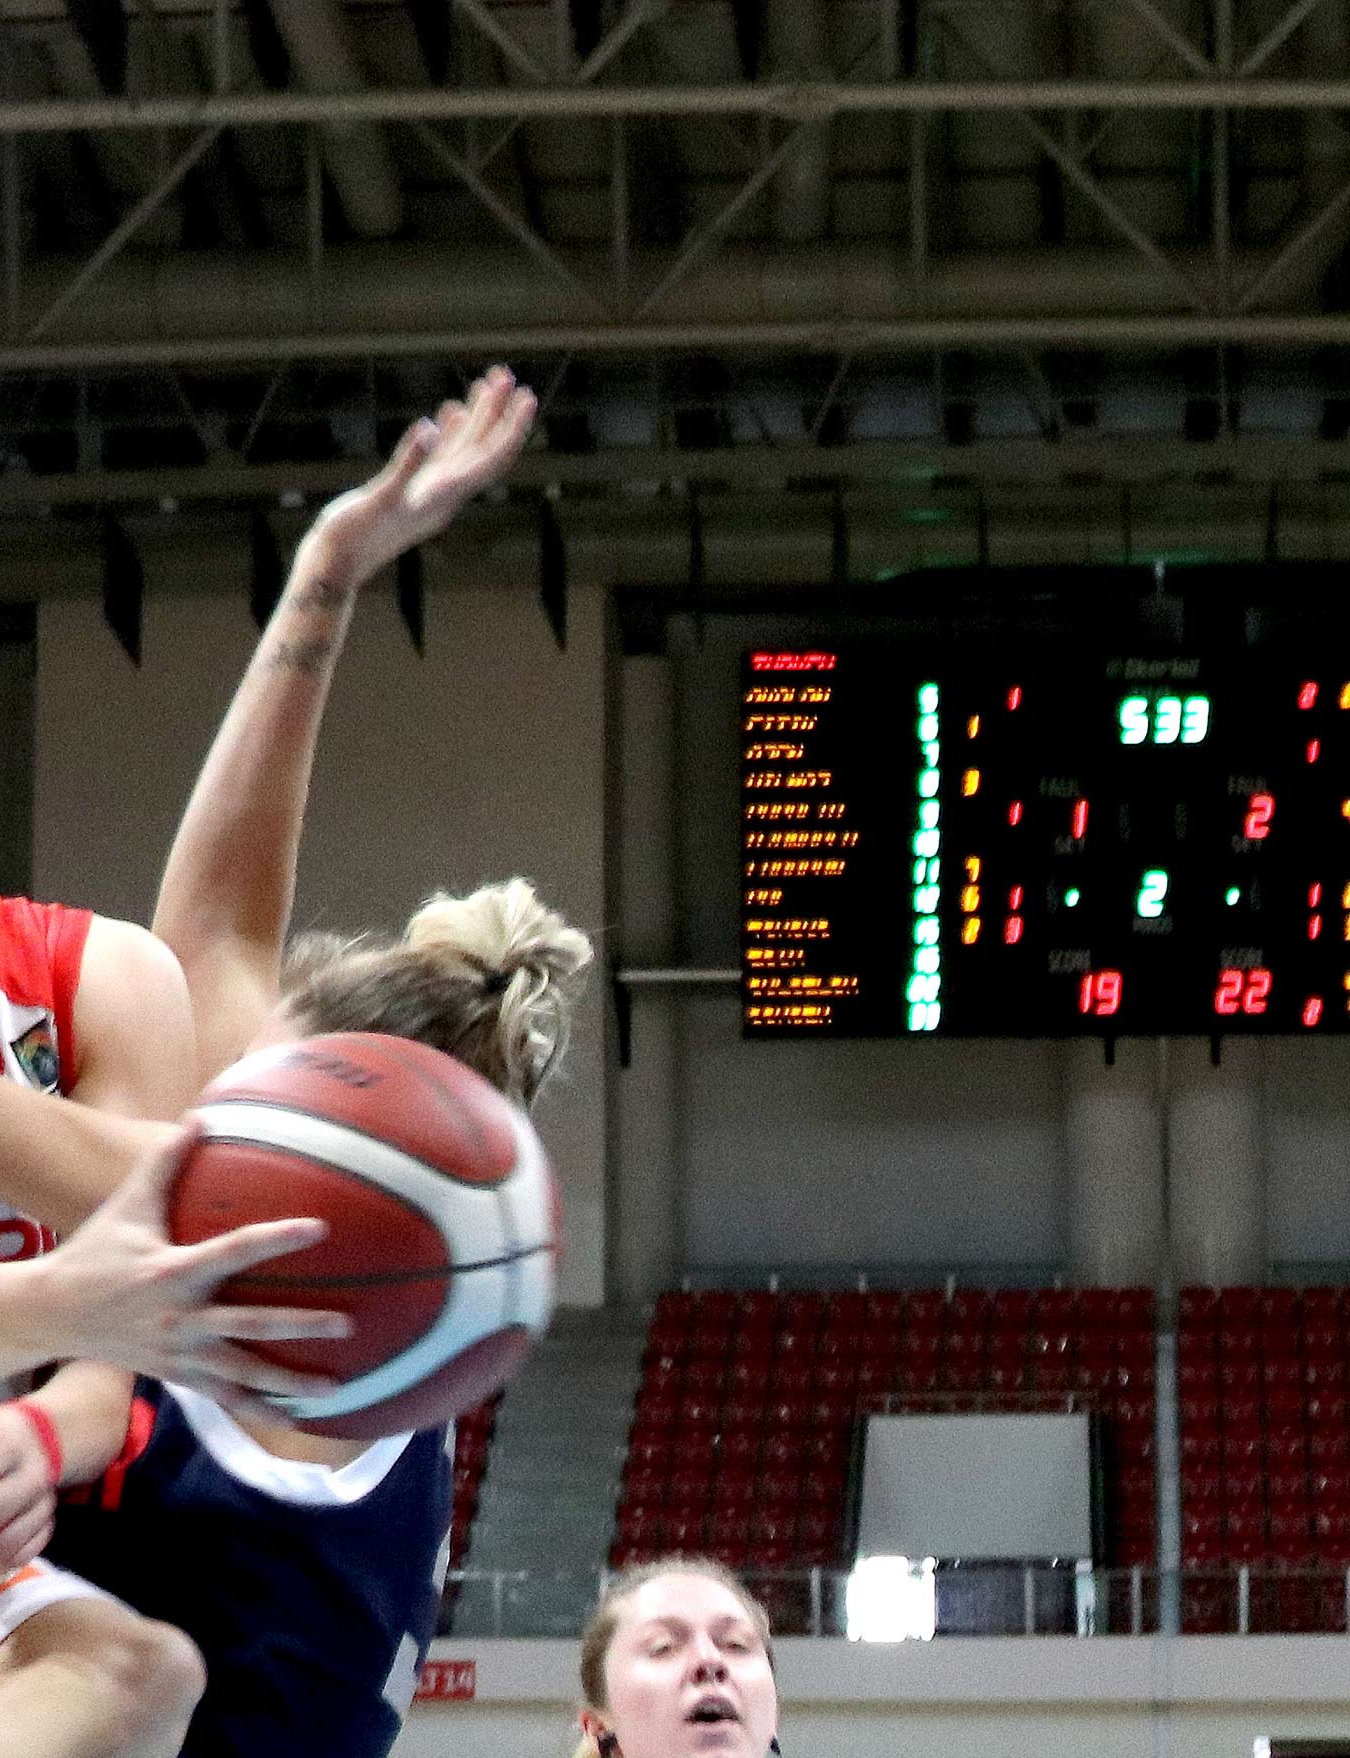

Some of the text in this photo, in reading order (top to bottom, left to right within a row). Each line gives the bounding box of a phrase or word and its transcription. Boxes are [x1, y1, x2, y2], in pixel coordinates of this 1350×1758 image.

[924, 741, 940, 768] 7
[1073, 801, 1088, 839] 1
[1245, 793, 1274, 839] 2
[1137, 870, 1168, 918] 2
[1080, 971, 1122, 1016] 19
[1215, 968, 1272, 1015] 22
